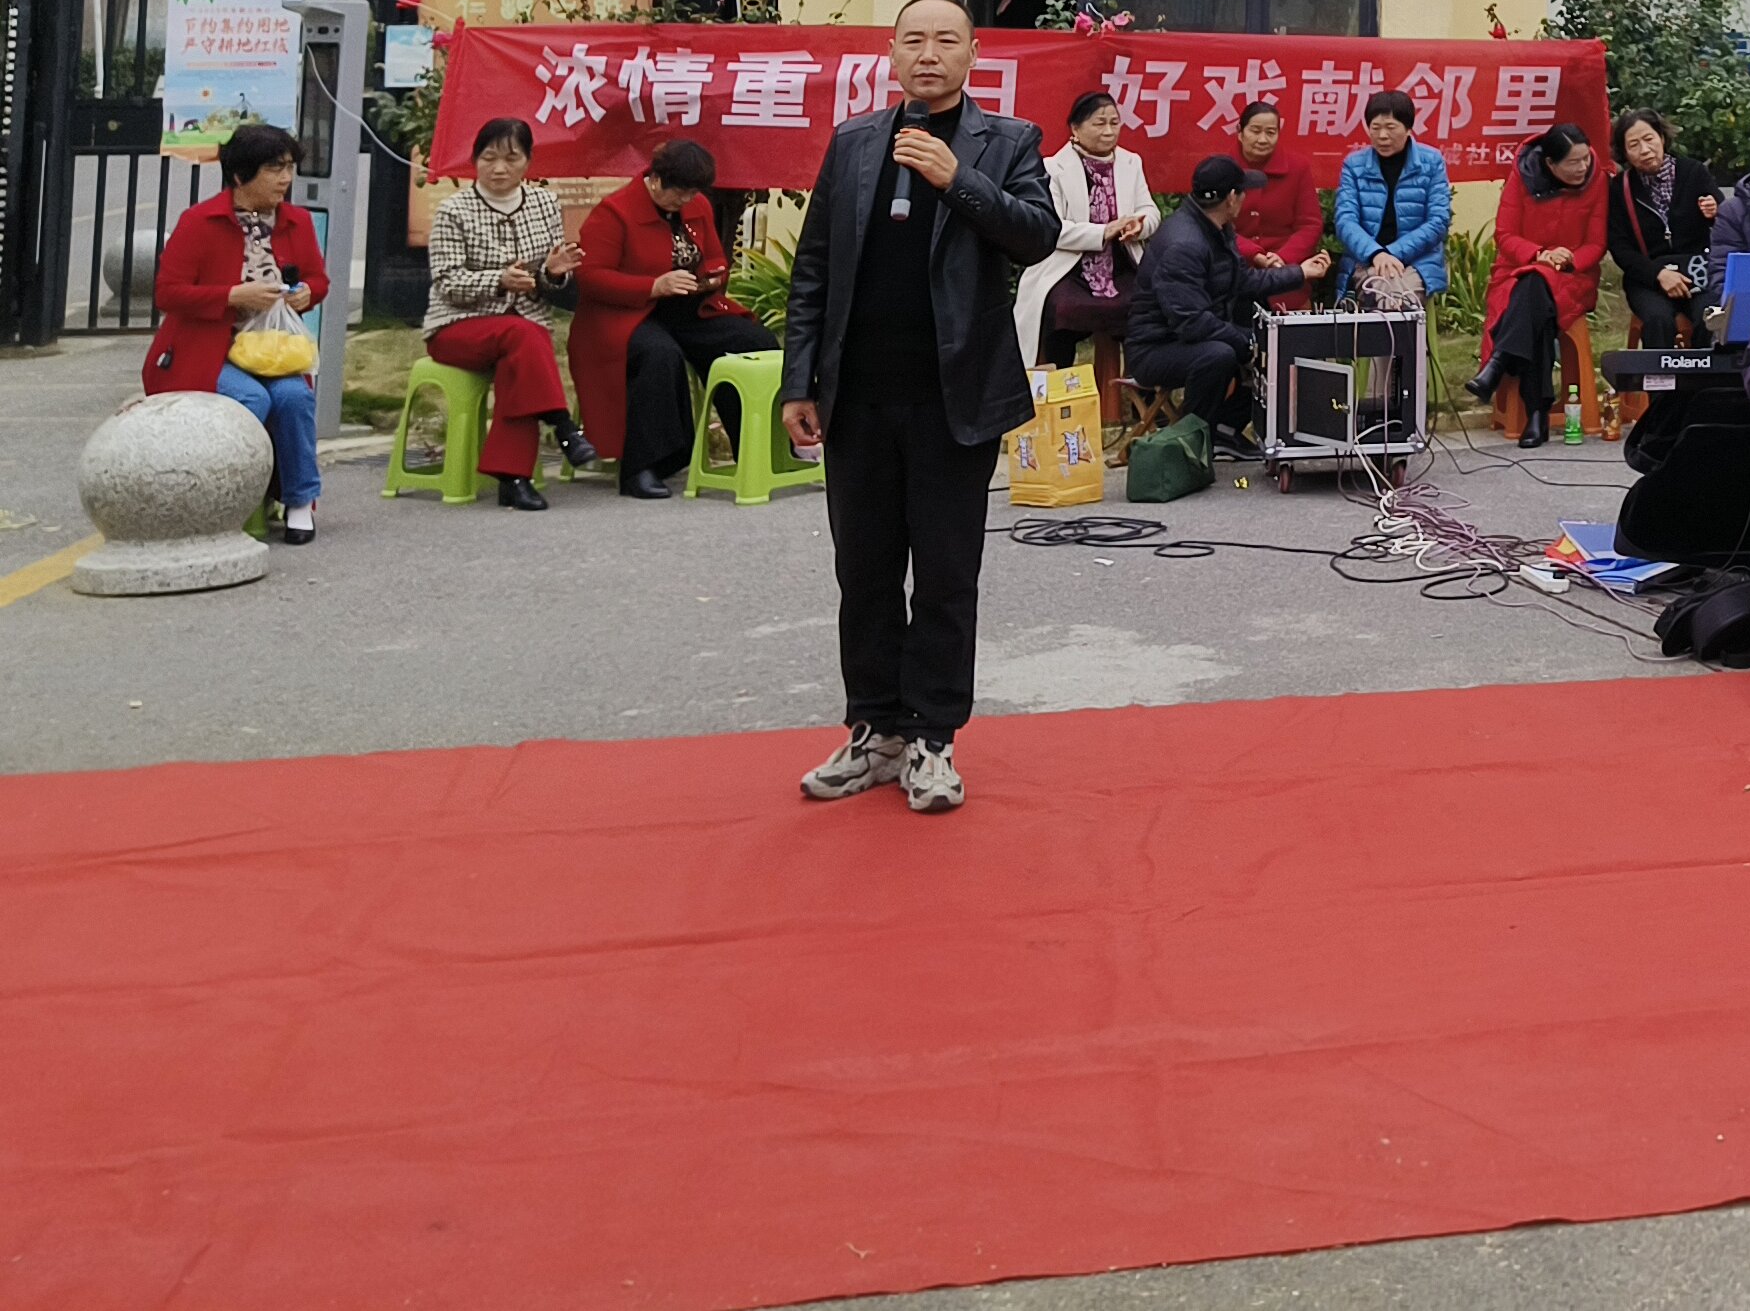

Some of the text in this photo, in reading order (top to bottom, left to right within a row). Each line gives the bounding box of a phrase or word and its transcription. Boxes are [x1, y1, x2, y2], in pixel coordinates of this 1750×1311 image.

[1101, 54, 1562, 139] 好戏献邻里
[1661, 355, 1711, 369] Roland
